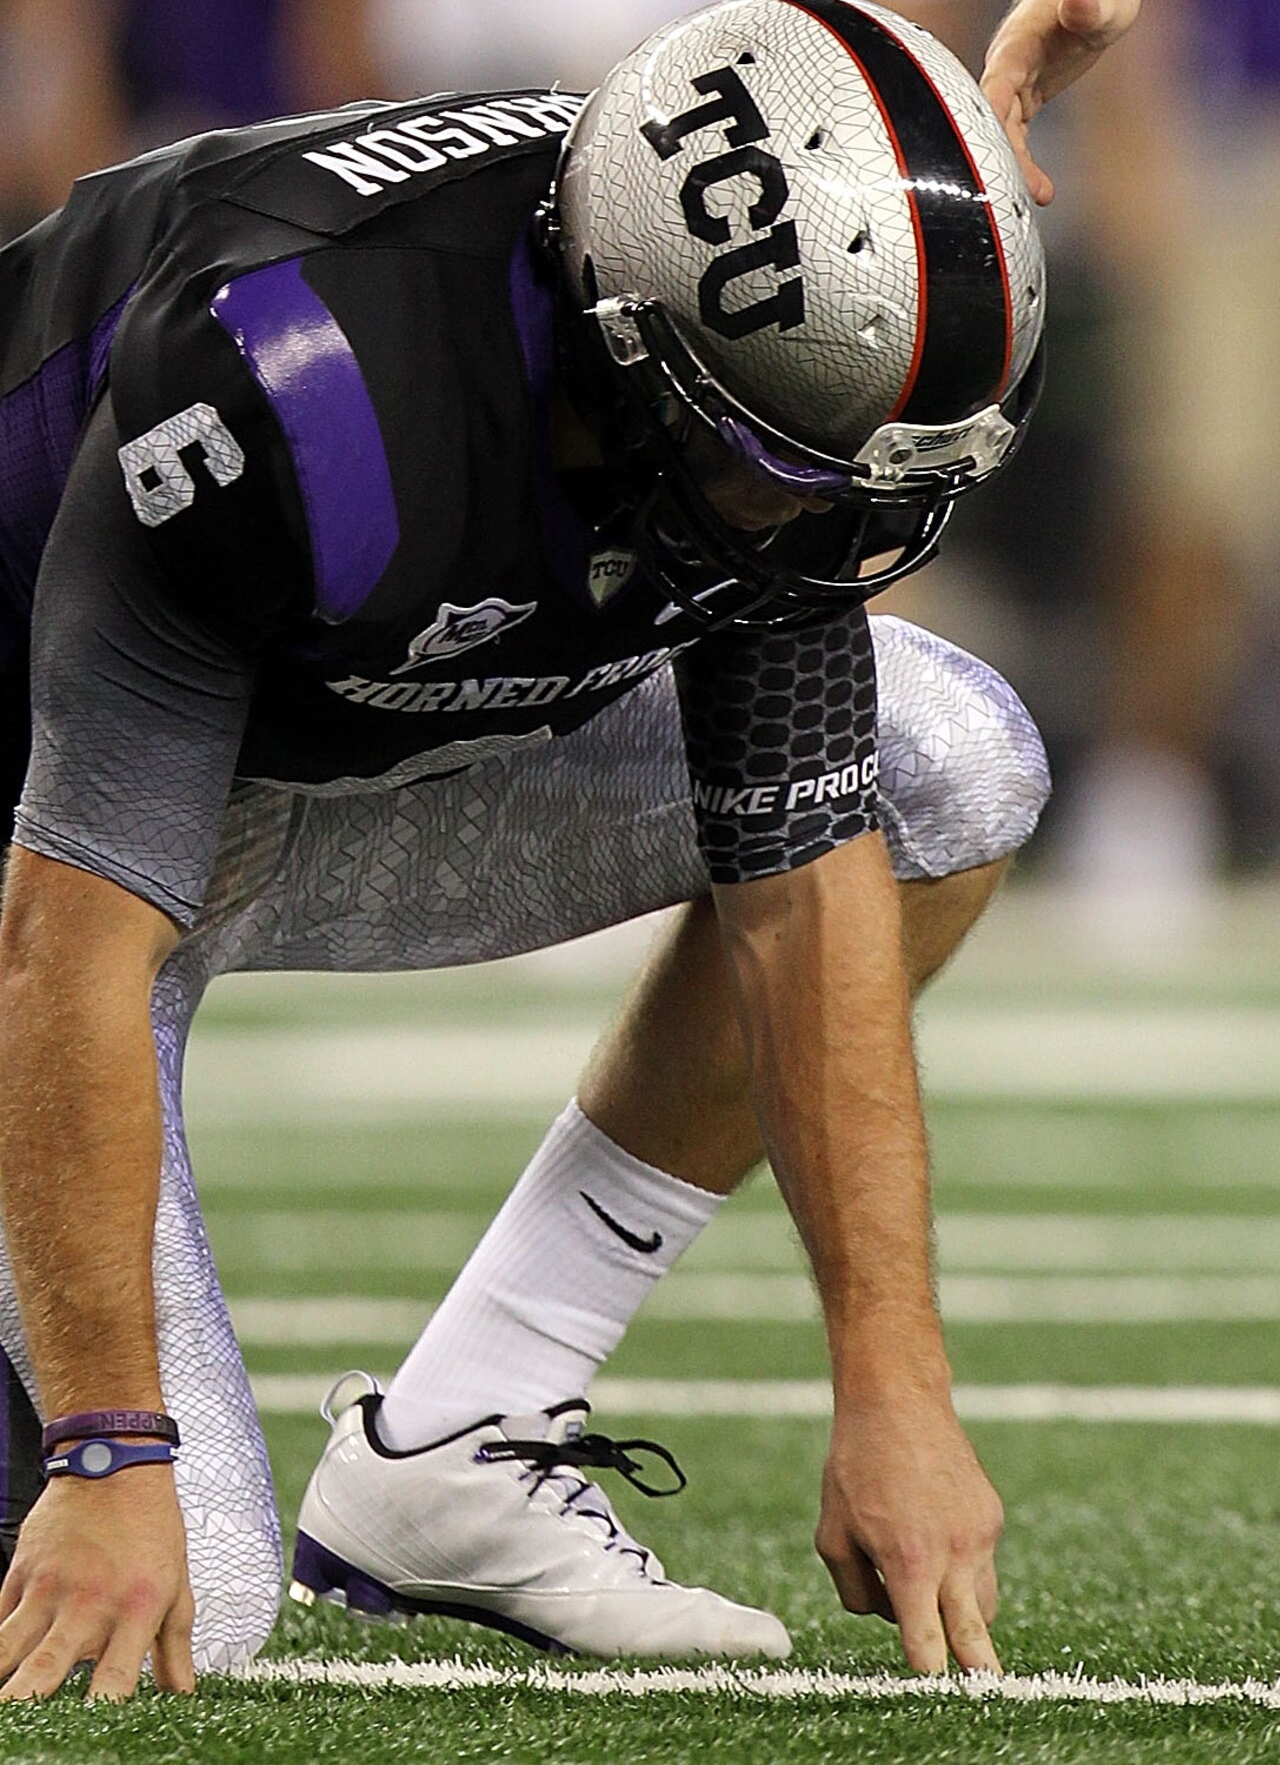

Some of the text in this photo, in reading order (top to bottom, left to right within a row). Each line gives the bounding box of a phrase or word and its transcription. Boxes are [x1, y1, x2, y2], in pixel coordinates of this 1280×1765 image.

[640, 66, 805, 342] TCU
[117, 401, 246, 529] 6
[592, 559, 630, 580] TCU
[324, 674, 571, 712] HORNED
[693, 779, 780, 816] NIKE
[784, 763, 859, 811] PRO
